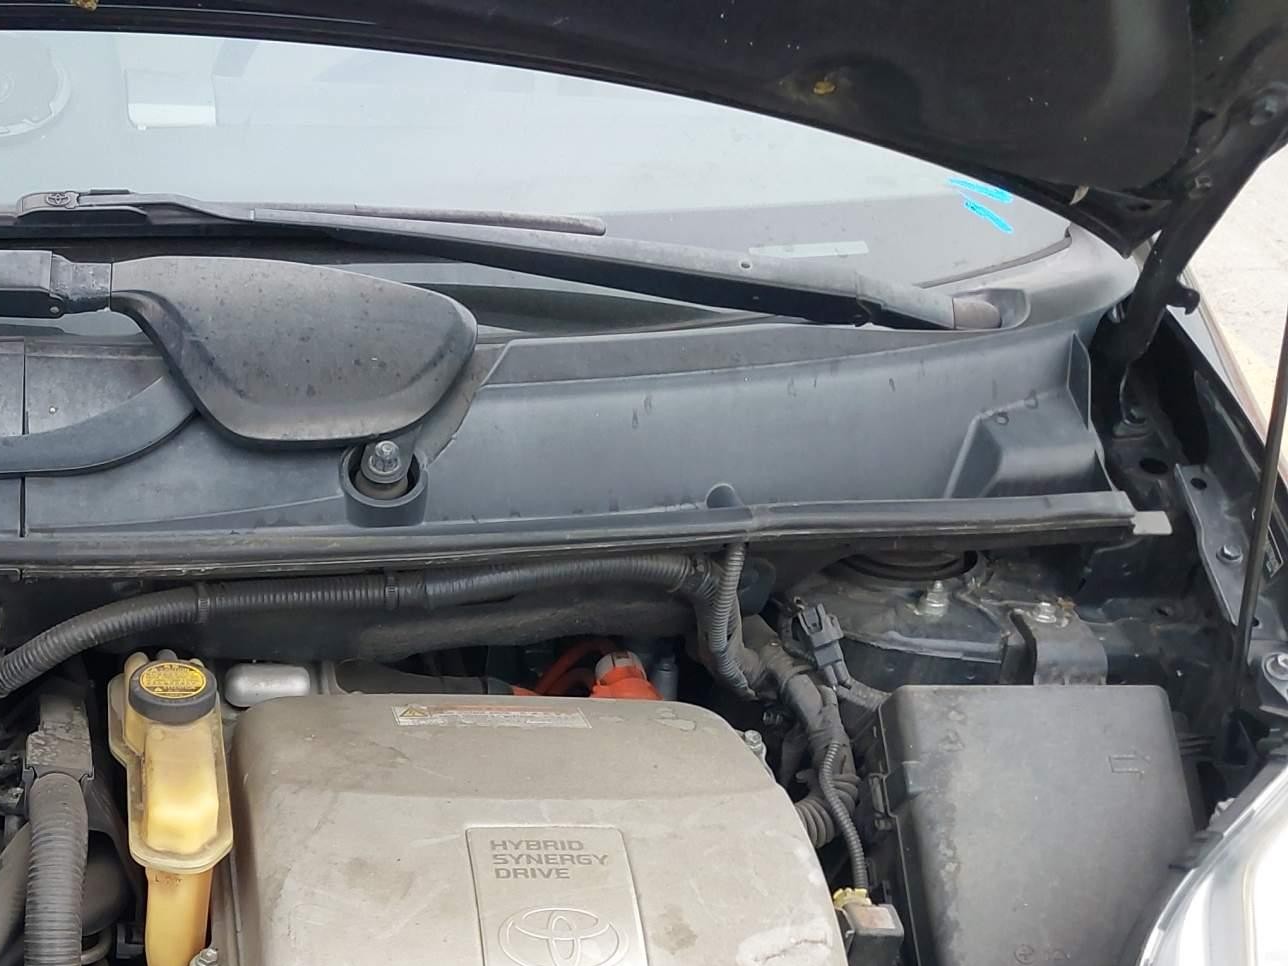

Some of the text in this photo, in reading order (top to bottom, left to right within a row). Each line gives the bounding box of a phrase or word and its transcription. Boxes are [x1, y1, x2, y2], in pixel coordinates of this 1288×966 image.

[490, 839, 584, 851] HYBRID
[493, 853, 609, 866] SYNERGY
[496, 867, 571, 880] DRIVE
